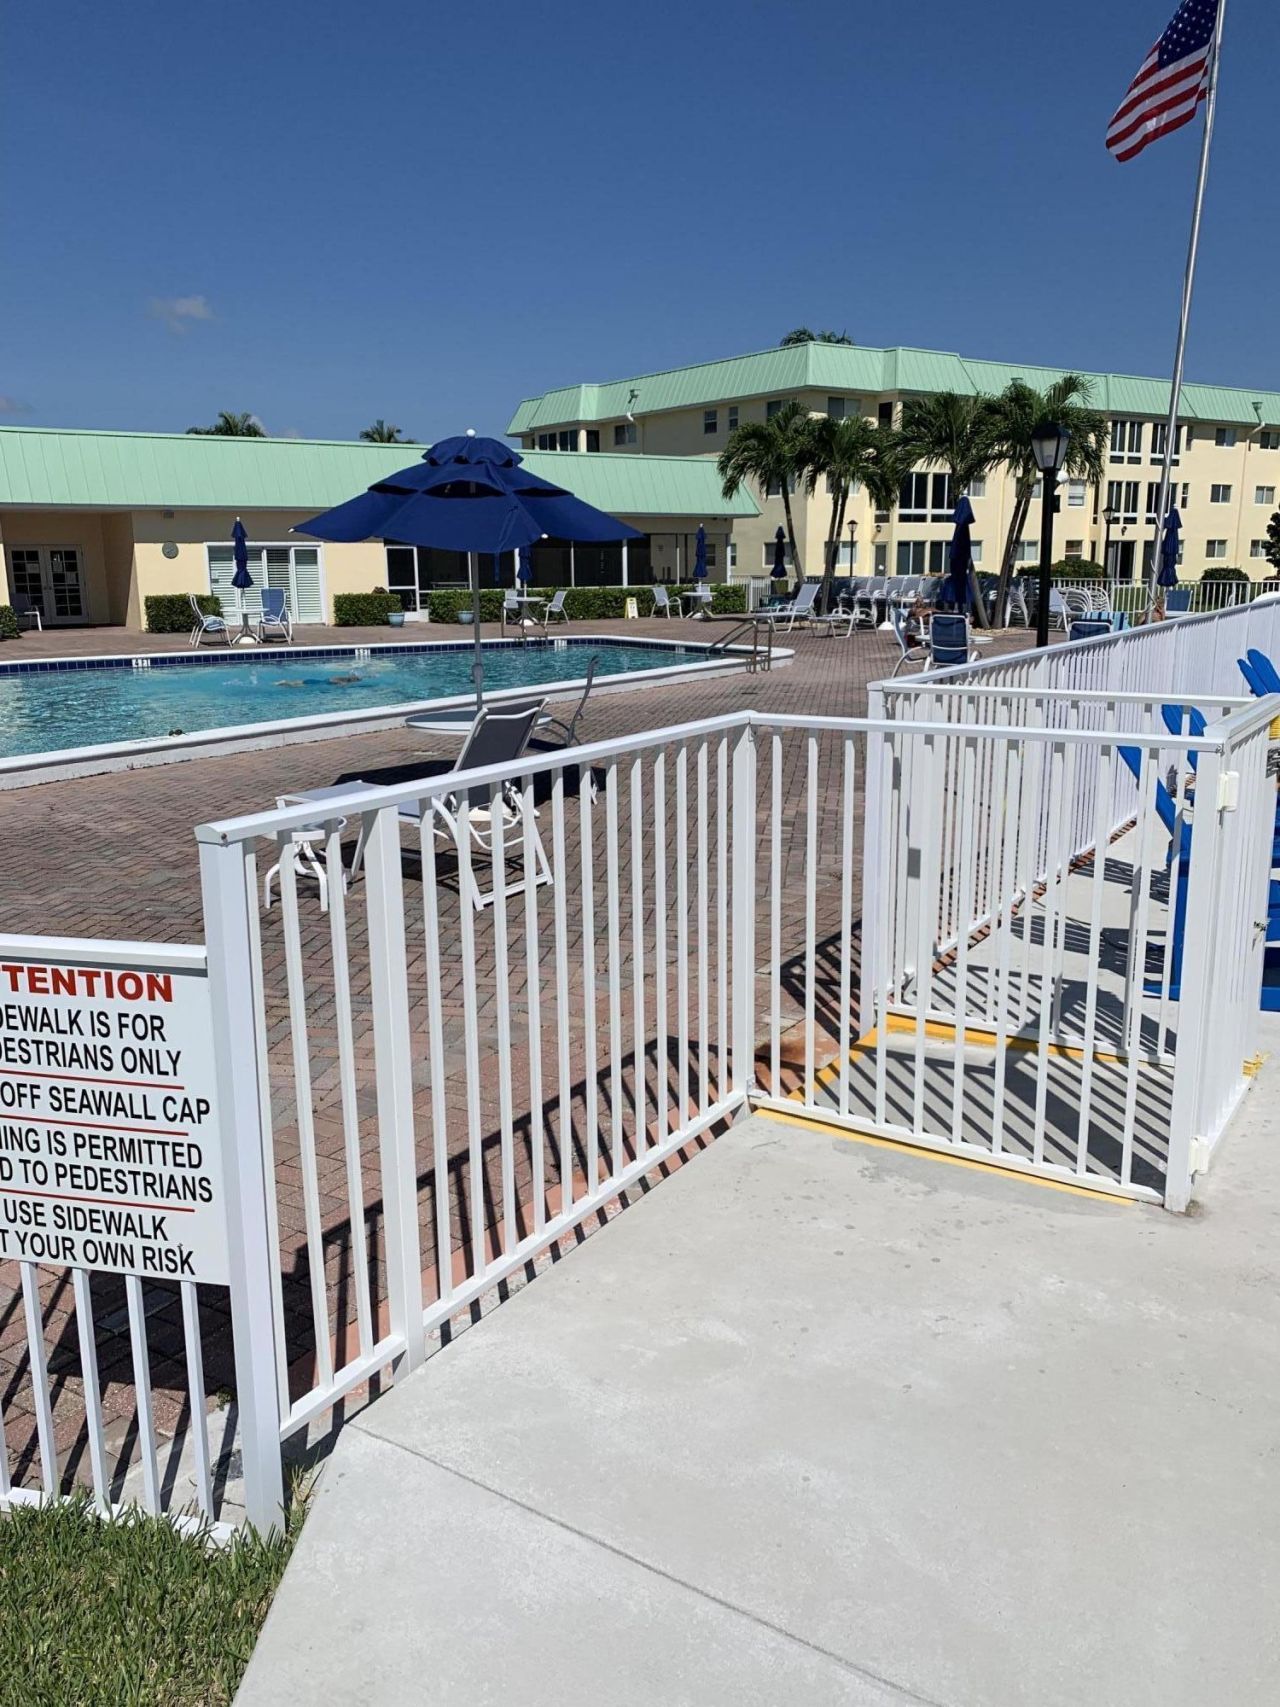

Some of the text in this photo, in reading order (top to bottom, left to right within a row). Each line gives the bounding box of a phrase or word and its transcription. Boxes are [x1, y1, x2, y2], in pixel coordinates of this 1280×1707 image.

[1, 964, 173, 1003] TENTION
[90, 1011, 110, 1038] IS
[118, 1013, 166, 1042] FOR
[0, 1037, 181, 1077] ESTRIANS ONLY
[0, 1081, 210, 1125] OFF SEAWALL CAP
[0, 1125, 202, 1169] ING IS PERMITTED
[18, 1159, 48, 1186] TO
[55, 1163, 213, 1202] PEDESTRIANS
[4, 1199, 168, 1242] USE SIDEWALK
[14, 1231, 77, 1262] YOUR
[83, 1239, 135, 1269] OWN
[142, 1246, 196, 1276] RISK
